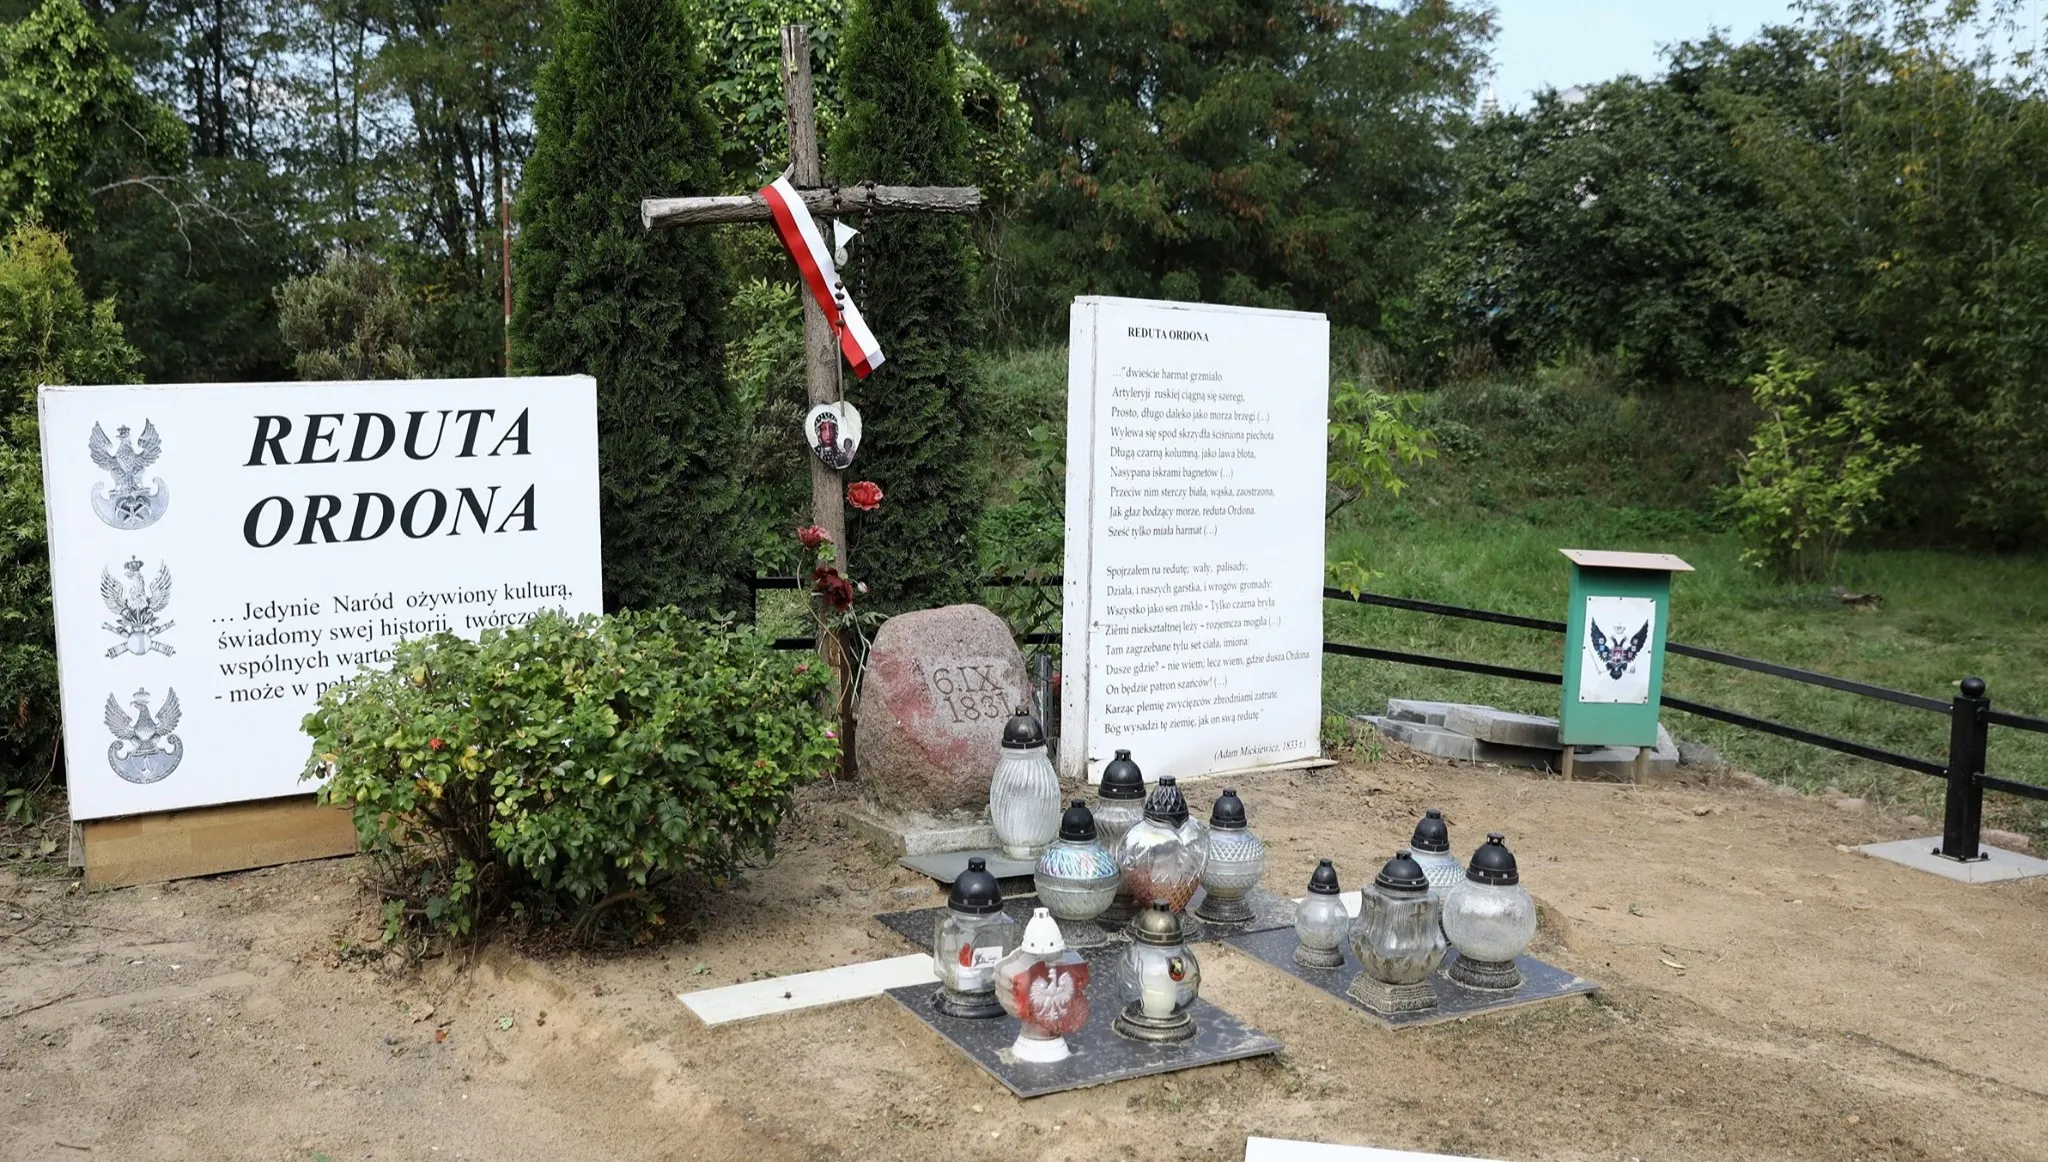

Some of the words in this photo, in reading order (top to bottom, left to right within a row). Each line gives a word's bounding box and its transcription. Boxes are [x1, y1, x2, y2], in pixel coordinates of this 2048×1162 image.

[1128, 326, 1167, 340] REDUTA
[1168, 329, 1209, 342] ORDONA
[1161, 368, 1189, 380] harmat
[1111, 386, 1150, 401] Artyleryji
[1154, 388, 1180, 402] ruskiej
[1181, 390, 1206, 403] ciągną
[1207, 390, 1217, 403] się
[1111, 406, 1139, 418] Prosto,
[1141, 407, 1164, 421] długo
[1165, 408, 1191, 419] daleko
[1192, 409, 1208, 422] jako
[1210, 411, 1232, 421] morza
[1234, 410, 1256, 424] brzegi
[243, 407, 532, 467] REDUTA
[1111, 426, 1143, 440] Wylewa
[1145, 428, 1156, 440] się
[1158, 428, 1177, 441] spod
[1178, 428, 1211, 442] skrzydła
[1246, 430, 1275, 443] piechota
[1110, 446, 1135, 460] Długą
[1137, 449, 1163, 460] czarną
[1201, 448, 1217, 460] jako
[1110, 466, 1151, 480] Nasypana
[1152, 466, 1181, 478] iskrami
[1182, 467, 1219, 480] bagnetów
[1110, 486, 1141, 497] Przeciw
[1143, 487, 1160, 497] nim
[1161, 488, 1187, 500] sterczy
[243, 483, 538, 549] ORDONA
[1109, 506, 1122, 519] Jak
[1142, 506, 1174, 519] bodzący
[1202, 506, 1226, 516] reduta
[1108, 526, 1130, 537] Sześć
[1131, 526, 1152, 539] tylko
[1153, 525, 1174, 536] miała
[1175, 525, 1202, 535] harmat
[1106, 564, 1150, 579] Spojrzałem
[1151, 566, 1161, 575] na
[1140, 582, 1171, 597] naszych
[1208, 583, 1237, 594] wrogów
[243, 598, 320, 623] Jedynie
[333, 592, 394, 614] Naród
[405, 586, 498, 611] ożywiony
[504, 581, 573, 601] kulturą,
[1107, 604, 1146, 619] Wszystko
[1147, 603, 1164, 616] jako
[1165, 605, 1178, 613] sen
[1210, 600, 1231, 613] Tylko
[1232, 600, 1256, 609] czarna
[218, 629, 323, 650] świadomy
[330, 620, 374, 642] swej
[1105, 645, 1124, 656] Tam
[1125, 642, 1172, 657] zagrzebane
[1173, 640, 1189, 654] tylu
[1190, 641, 1202, 650] set
[219, 650, 329, 679] wspólnych
[1106, 664, 1132, 675] Dusze
[1167, 661, 1180, 671] nie
[1207, 658, 1222, 668] lecz
[229, 683, 285, 703] może
[291, 683, 309, 697] w
[1106, 684, 1119, 695] On
[1121, 682, 1148, 696] będzie
[1149, 681, 1176, 694] patron
[943, 691, 1014, 723] 1831
[1105, 704, 1134, 716] Karząc
[1136, 700, 1164, 715] plemię
[1213, 692, 1253, 705] zbrodniami
[1104, 723, 1121, 736] Bóg
[1123, 719, 1159, 735] wysadzi
[1160, 720, 1168, 732] tę
[1198, 715, 1210, 727] jak
[1210, 716, 1220, 724] on
[1221, 713, 1236, 724] swą
[1213, 748, 1238, 761] (Adam
[1282, 740, 1298, 751] 1833
